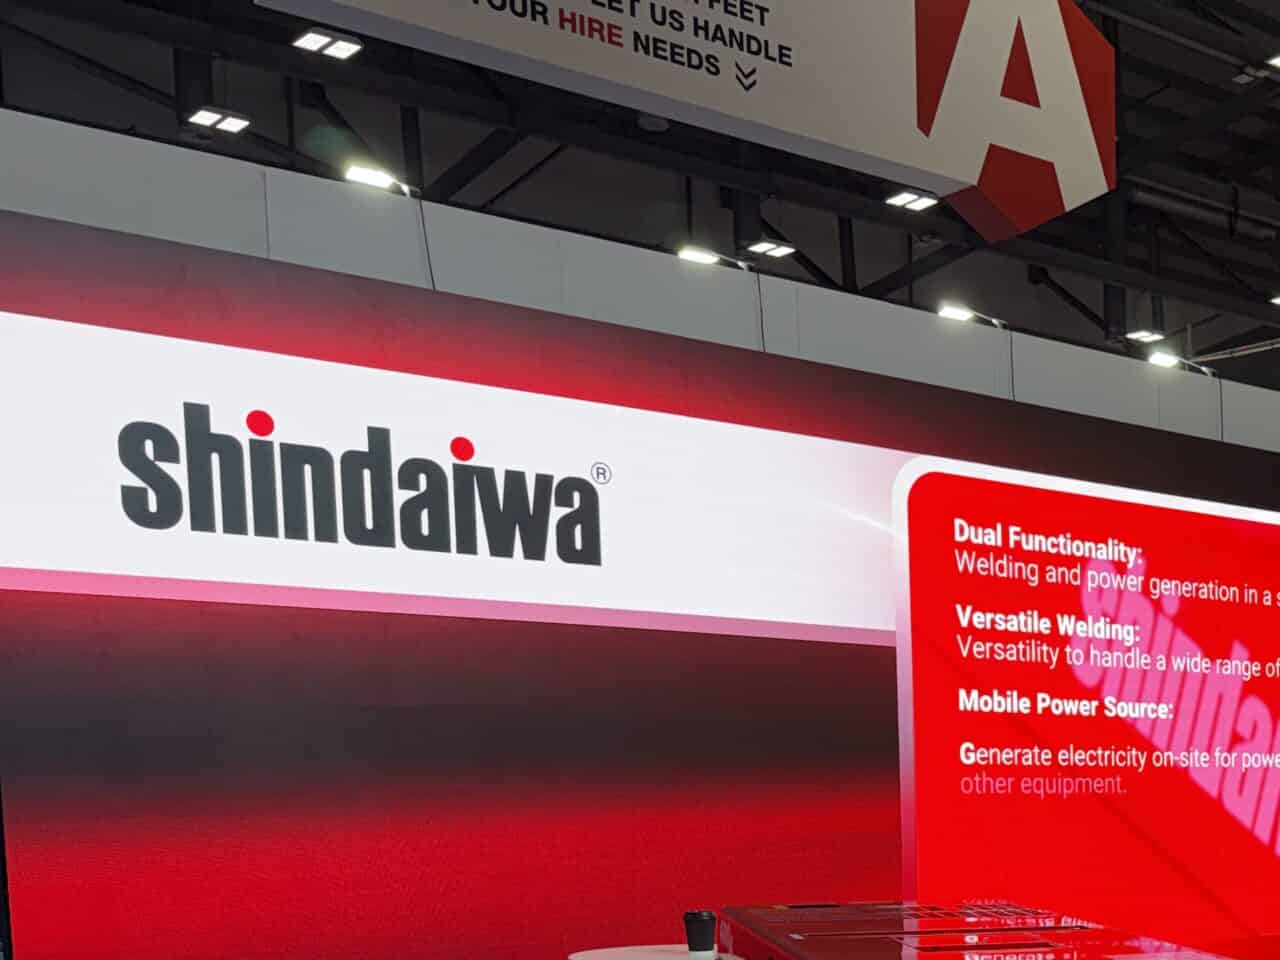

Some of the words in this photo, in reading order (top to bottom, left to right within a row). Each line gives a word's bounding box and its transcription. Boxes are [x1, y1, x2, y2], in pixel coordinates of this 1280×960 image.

[472, 0, 550, 25] OUR
[559, 8, 624, 48] HIRE
[633, 31, 721, 76] NEEDS
[650, 3, 684, 32] US
[693, 16, 793, 67] HANDLE
[953, 518, 1002, 547] Dual
[1008, 525, 1143, 568] Functionality:
[955, 548, 1039, 586] Welding
[1045, 563, 1081, 586] and
[1087, 570, 1144, 592] power
[1149, 576, 1240, 604] generation
[1243, 583, 1258, 604] in
[1263, 589, 1272, 606] a
[955, 603, 1051, 635] Versatile
[1056, 613, 1141, 647] Welding:
[956, 634, 1060, 669] Versatility
[1065, 644, 1084, 665] to
[1090, 645, 1151, 670] handle
[1156, 654, 1166, 672] a
[1171, 652, 1211, 673] wide
[1215, 658, 1261, 682] range
[959, 688, 1031, 713] Mobile
[1037, 692, 1099, 716] Power
[1104, 695, 1174, 719] Source:
[959, 741, 1052, 766] Generate
[1057, 744, 1148, 772] electricity
[1152, 747, 1209, 768] on-site
[1214, 746, 1237, 767] for
[960, 770, 1015, 794] other
[1020, 775, 1127, 799] equipment.
